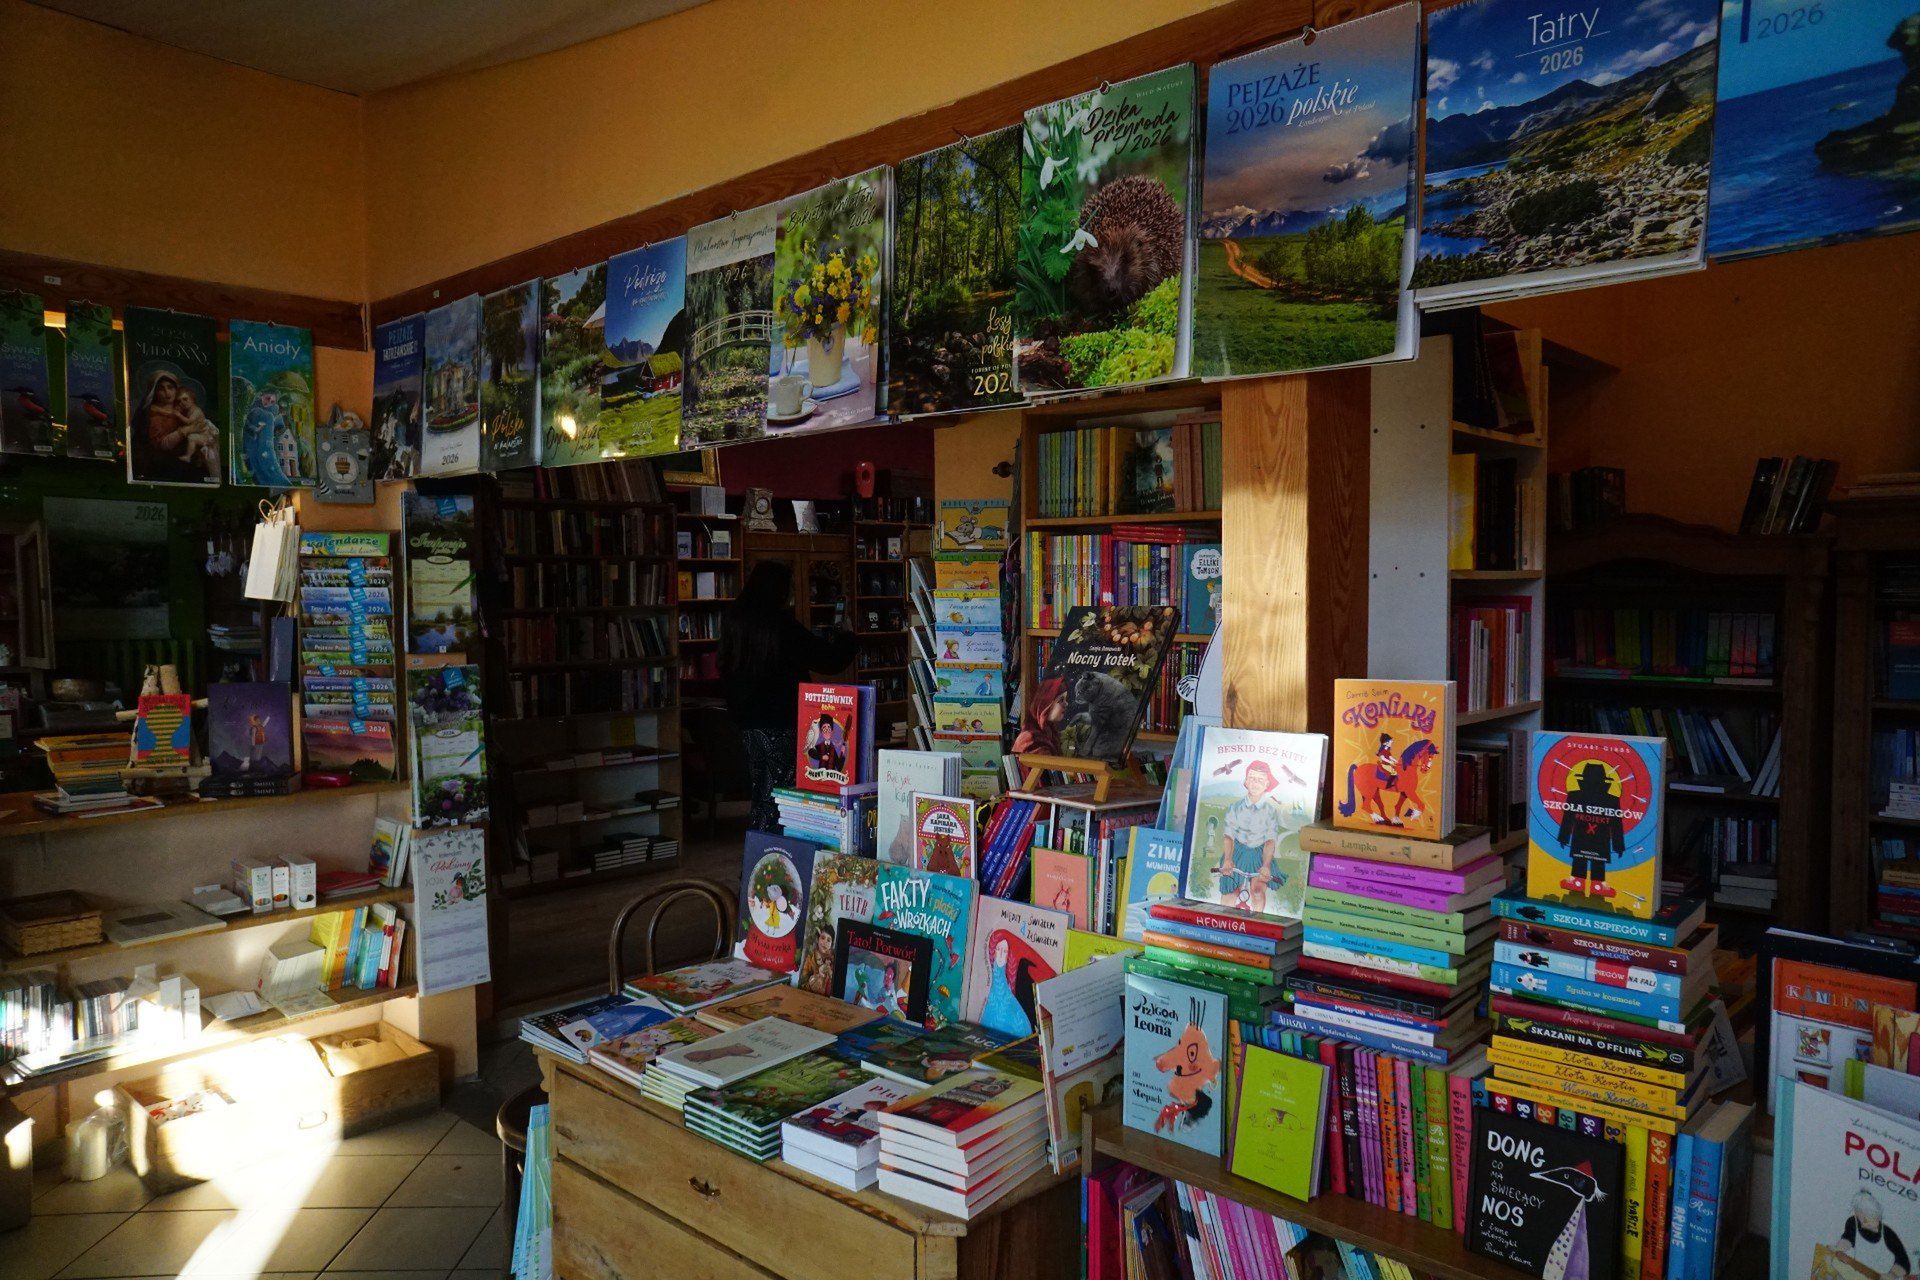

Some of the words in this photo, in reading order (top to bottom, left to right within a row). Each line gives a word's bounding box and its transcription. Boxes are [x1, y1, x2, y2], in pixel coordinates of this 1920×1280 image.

[1528, 9, 1598, 47] Tatry
[1758, 6, 1823, 40] 2026
[1540, 48, 1583, 75] 2026
[1226, 63, 1322, 108] PEJZAŻE
[1083, 97, 1142, 137] Dzika
[1226, 98, 1286, 136] 2026
[1286, 81, 1359, 125] polskie
[1092, 110, 1180, 154] przyroda
[1132, 133, 1170, 154] 2026
[849, 206, 876, 230] 2026
[717, 265, 747, 285] 2026
[243, 336, 301, 360] Anioły
[441, 454, 460, 466] 2026
[134, 506, 165, 522] 2026
[1067, 651, 1101, 668] Nocny
[1104, 653, 1136, 667] kotek
[1342, 692, 1437, 734] KONIARA
[1217, 744, 1255, 754] BESKID
[1259, 745, 1279, 756] BEZ
[1281, 750, 1308, 764] KITU
[1543, 800, 1584, 814] SZKOŁA
[1586, 804, 1644, 821] SZPIEGÓW
[1587, 823, 1598, 836] X
[1341, 839, 1377, 853] Lampka
[881, 878, 931, 911] FAKTY
[896, 909, 952, 938] WRÓŻKACH
[1553, 913, 1592, 929] SZKOŁA
[1594, 920, 1649, 938] SZPIEGÓW
[1573, 938, 1604, 951] SZKOŁA
[1606, 943, 1650, 959] SZPIEGÓW
[1134, 1015, 1172, 1038] Leona
[1531, 1026, 1576, 1043] SKAZANI
[1578, 1035, 1593, 1047] NA
[1596, 1040, 1643, 1058] OFFLINE
[1487, 1130, 1546, 1168] DONG
[1491, 1159, 1504, 1170] CO
[1491, 1171, 1504, 1182] MA
[1858, 1165, 1918, 1202] piecze
[1482, 1194, 1525, 1228] NOS
